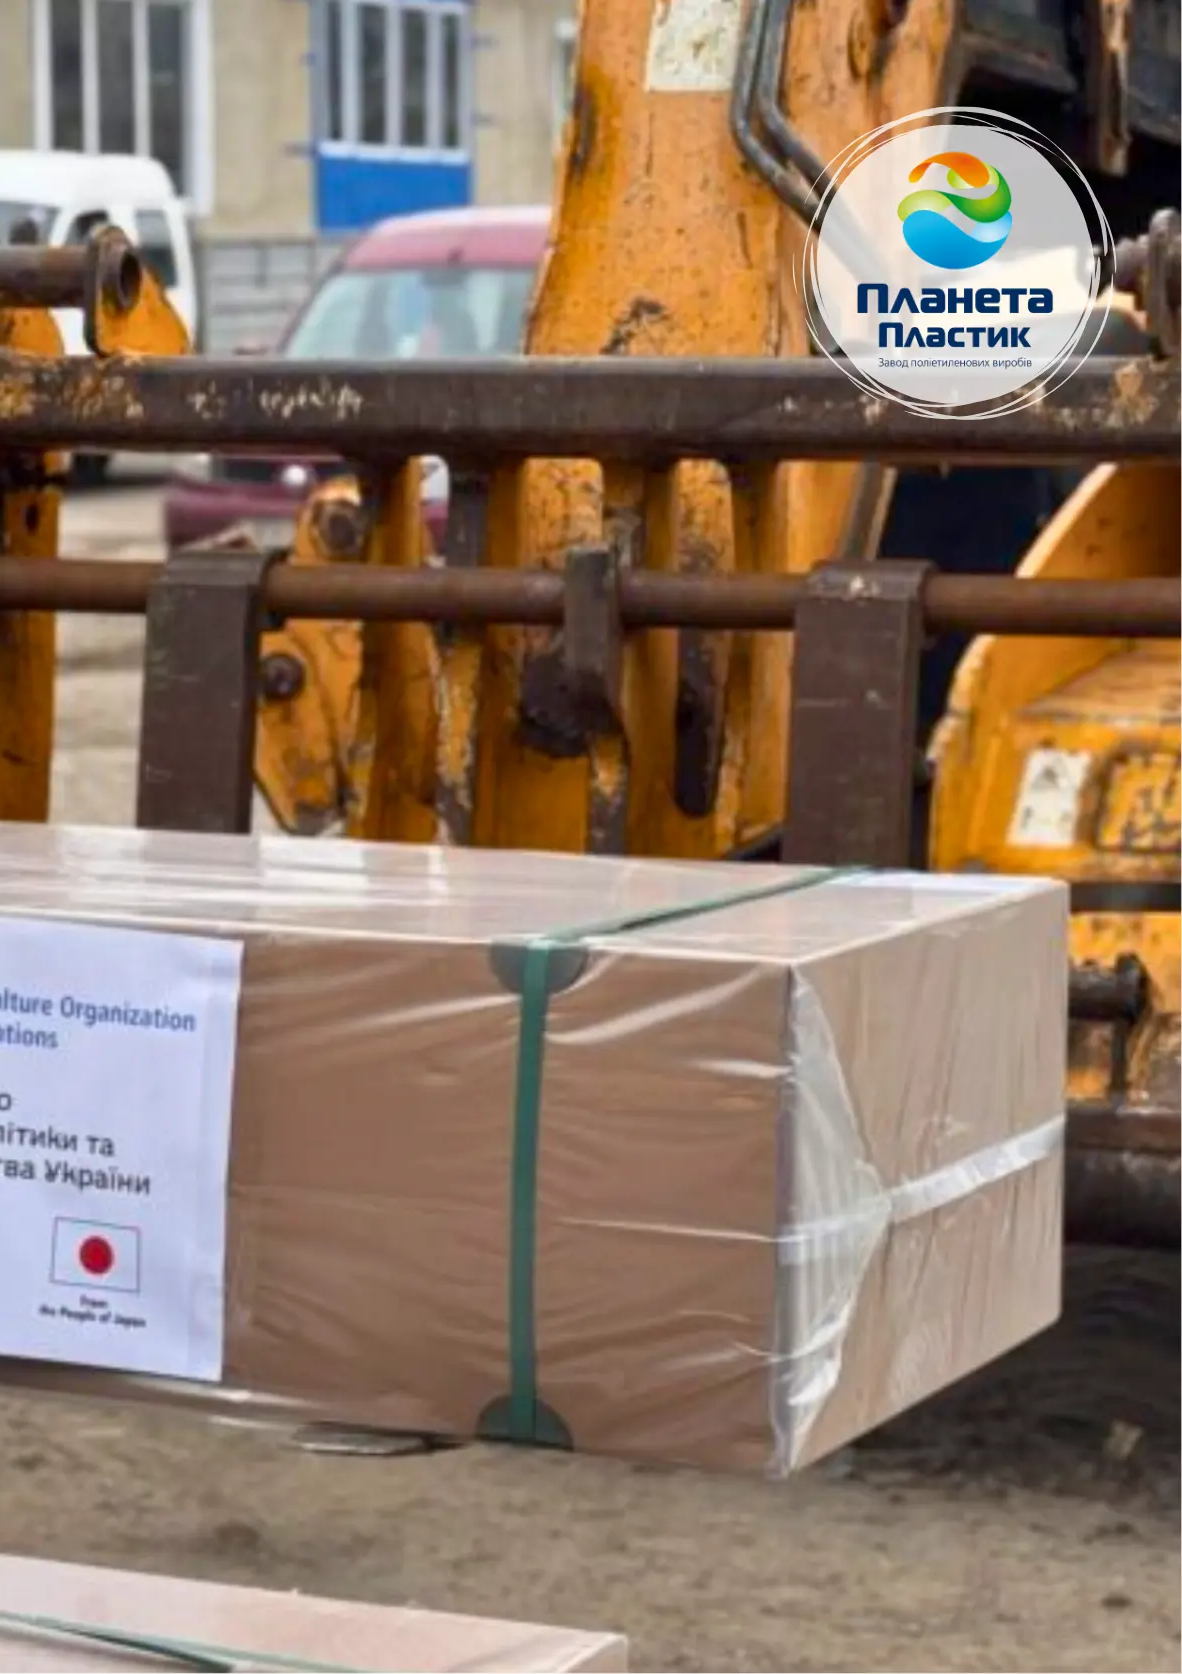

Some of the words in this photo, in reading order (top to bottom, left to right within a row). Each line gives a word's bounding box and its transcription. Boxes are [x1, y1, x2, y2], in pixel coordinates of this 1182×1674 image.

[59, 995, 197, 1033] Organization
[85, 1132, 116, 1157] та
[44, 1159, 152, 1195] України
